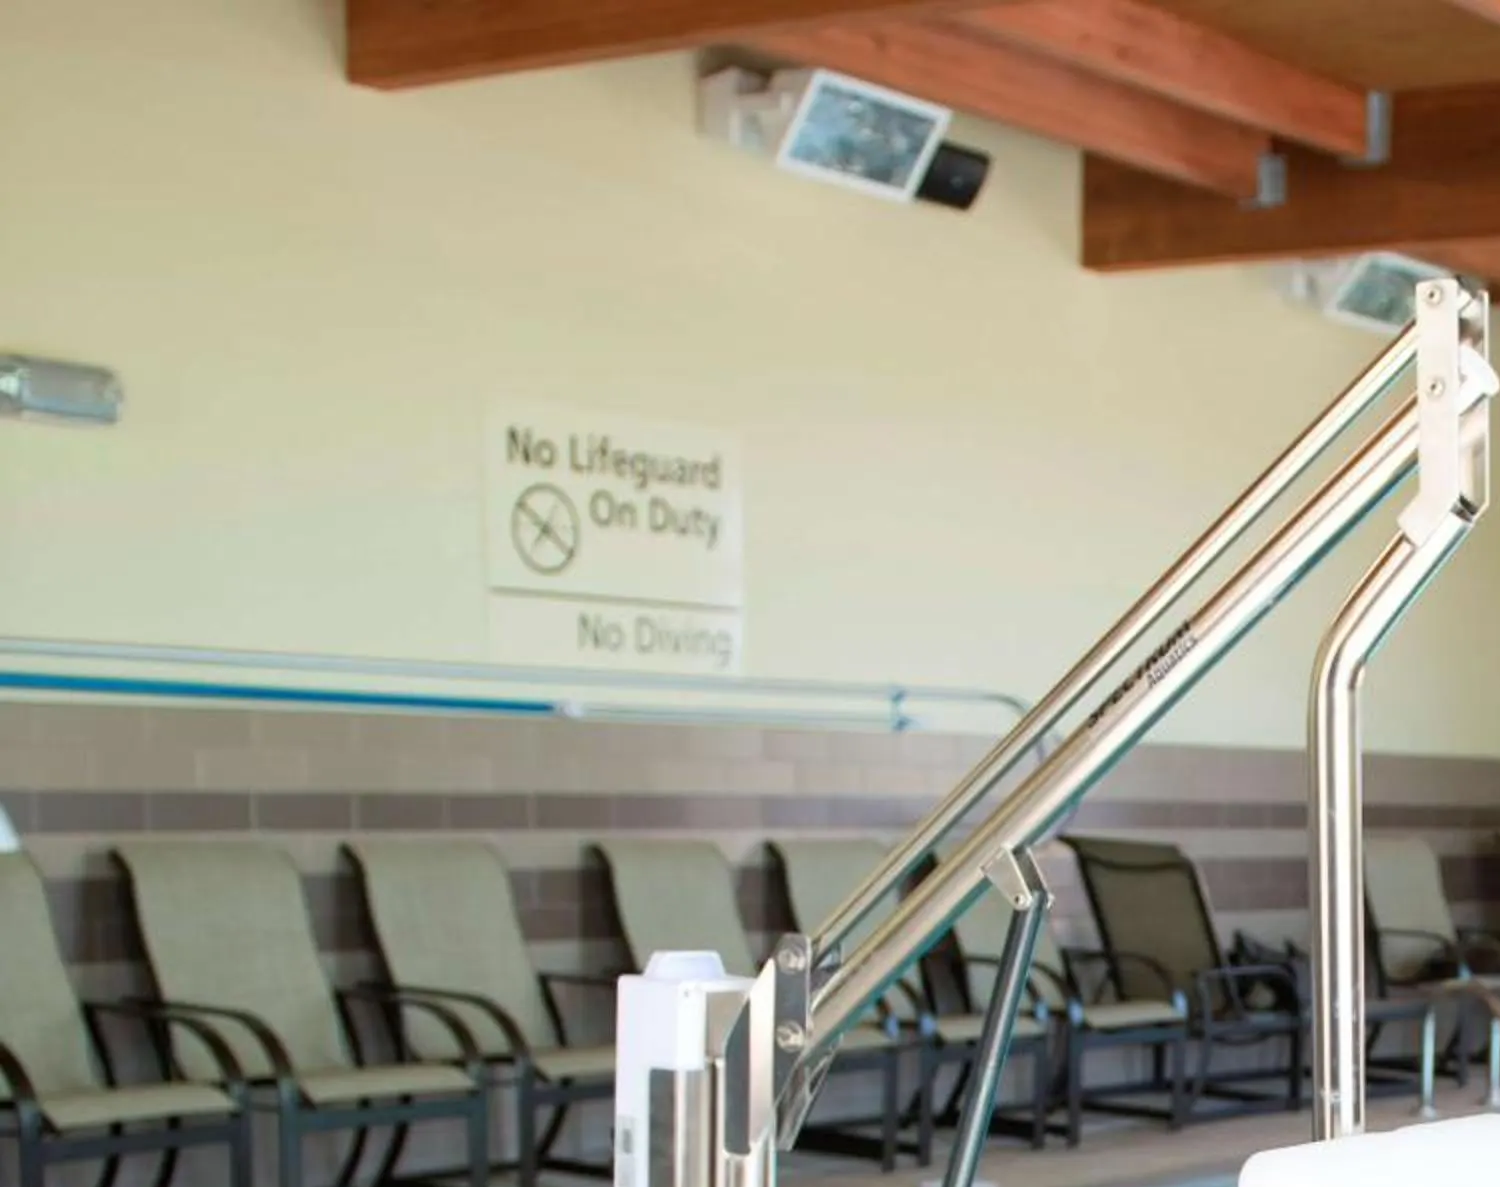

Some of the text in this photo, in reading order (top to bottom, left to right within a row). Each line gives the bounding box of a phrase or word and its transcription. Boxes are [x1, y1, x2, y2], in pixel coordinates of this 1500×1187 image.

[506, 425, 722, 490] No Lifeguard
[588, 488, 720, 550] On Duty
[577, 612, 734, 669] No Diving
